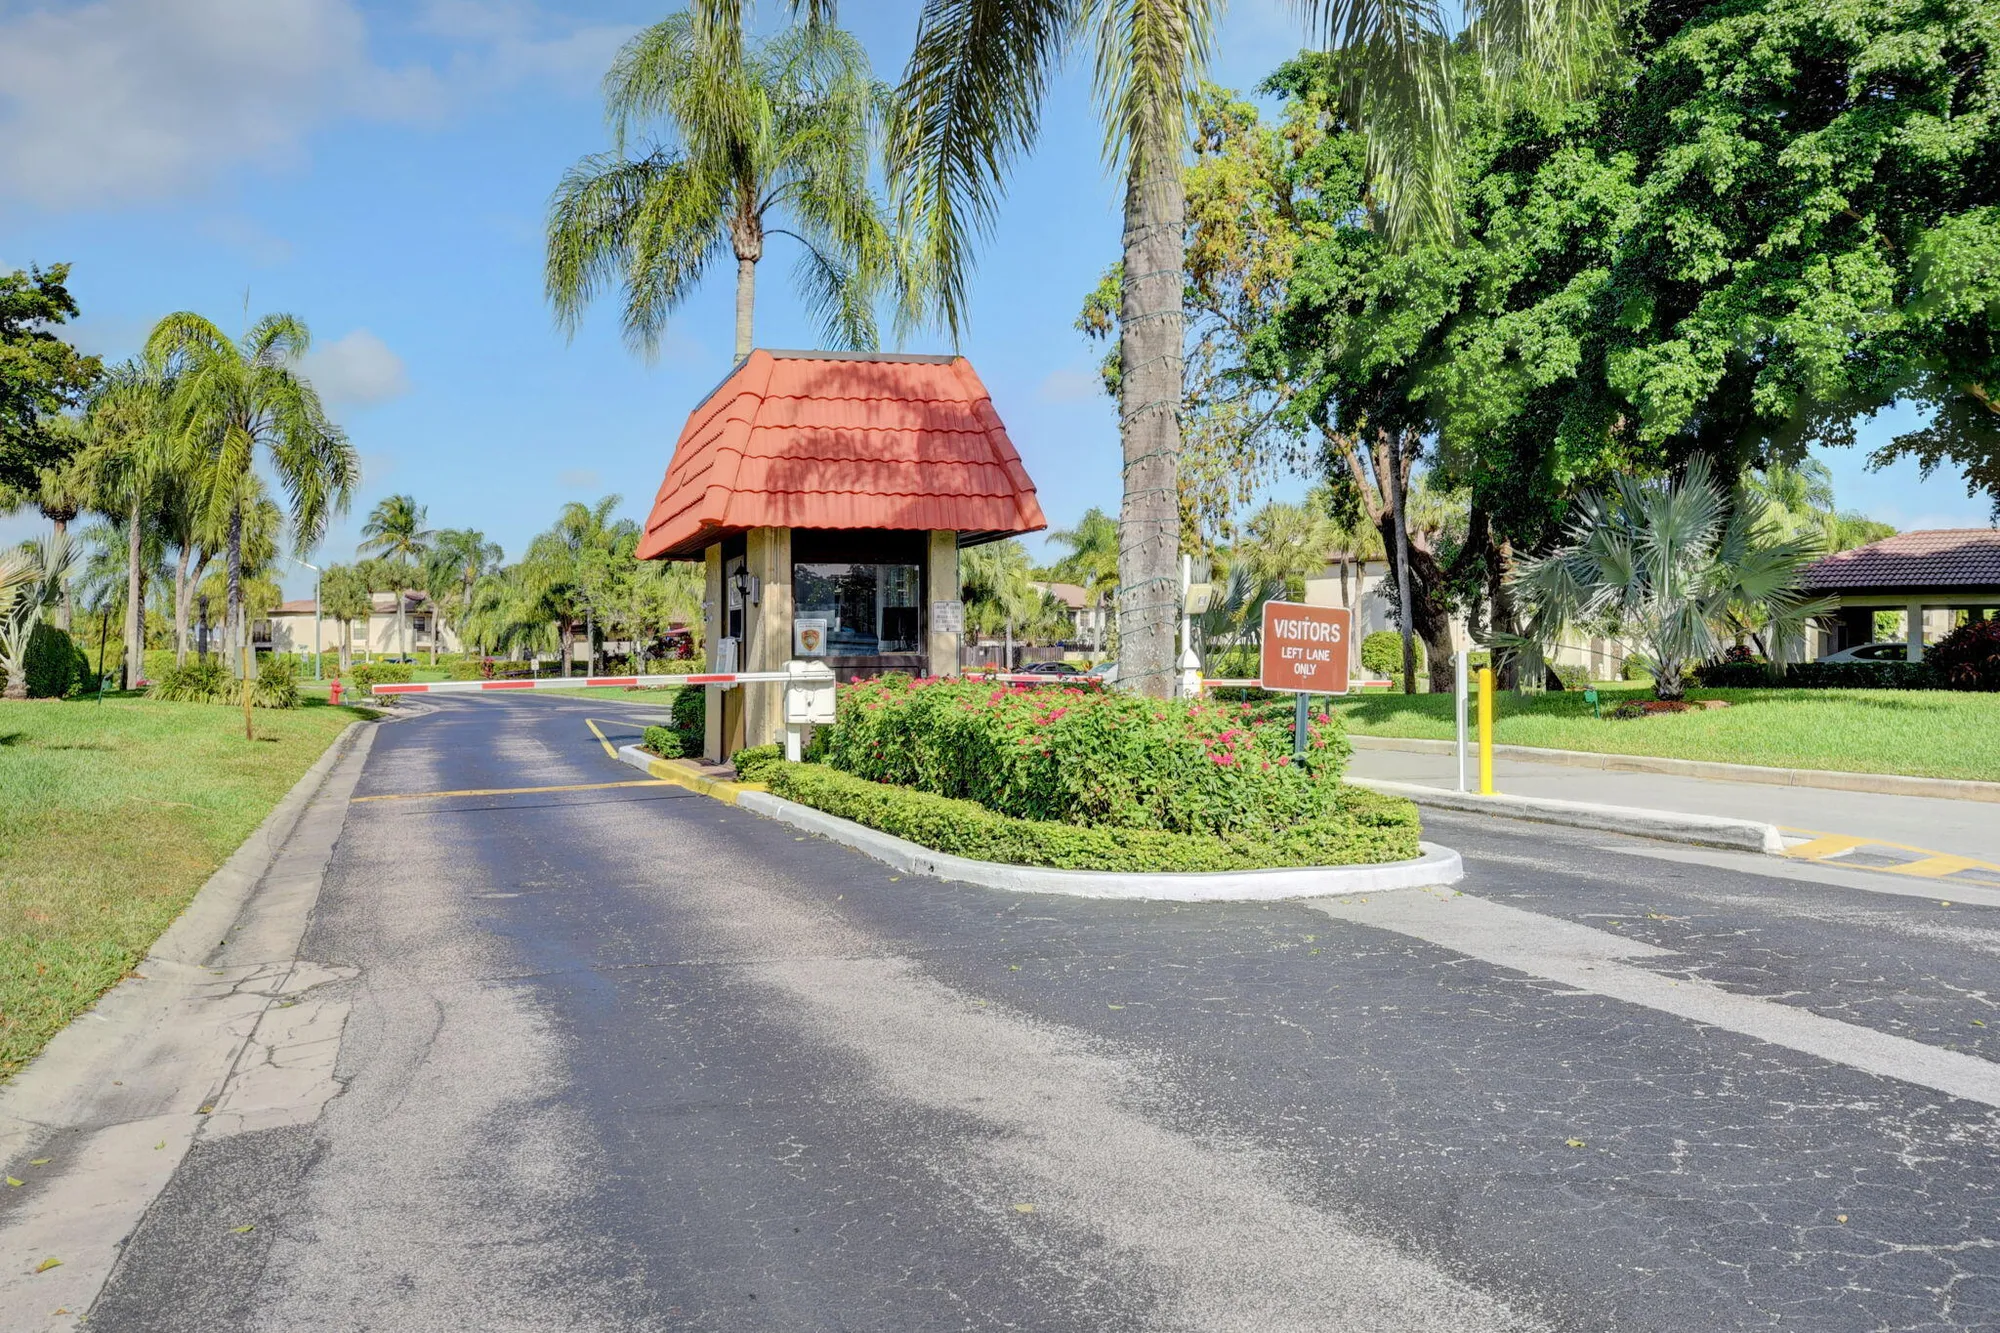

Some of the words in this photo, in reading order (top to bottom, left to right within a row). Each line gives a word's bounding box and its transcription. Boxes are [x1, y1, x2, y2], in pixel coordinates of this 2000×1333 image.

[1274, 618, 1341, 643] VISITORS
[1281, 646, 1303, 660] LEFT
[1306, 648, 1330, 661] LANE
[1294, 663, 1317, 675] ONLY
